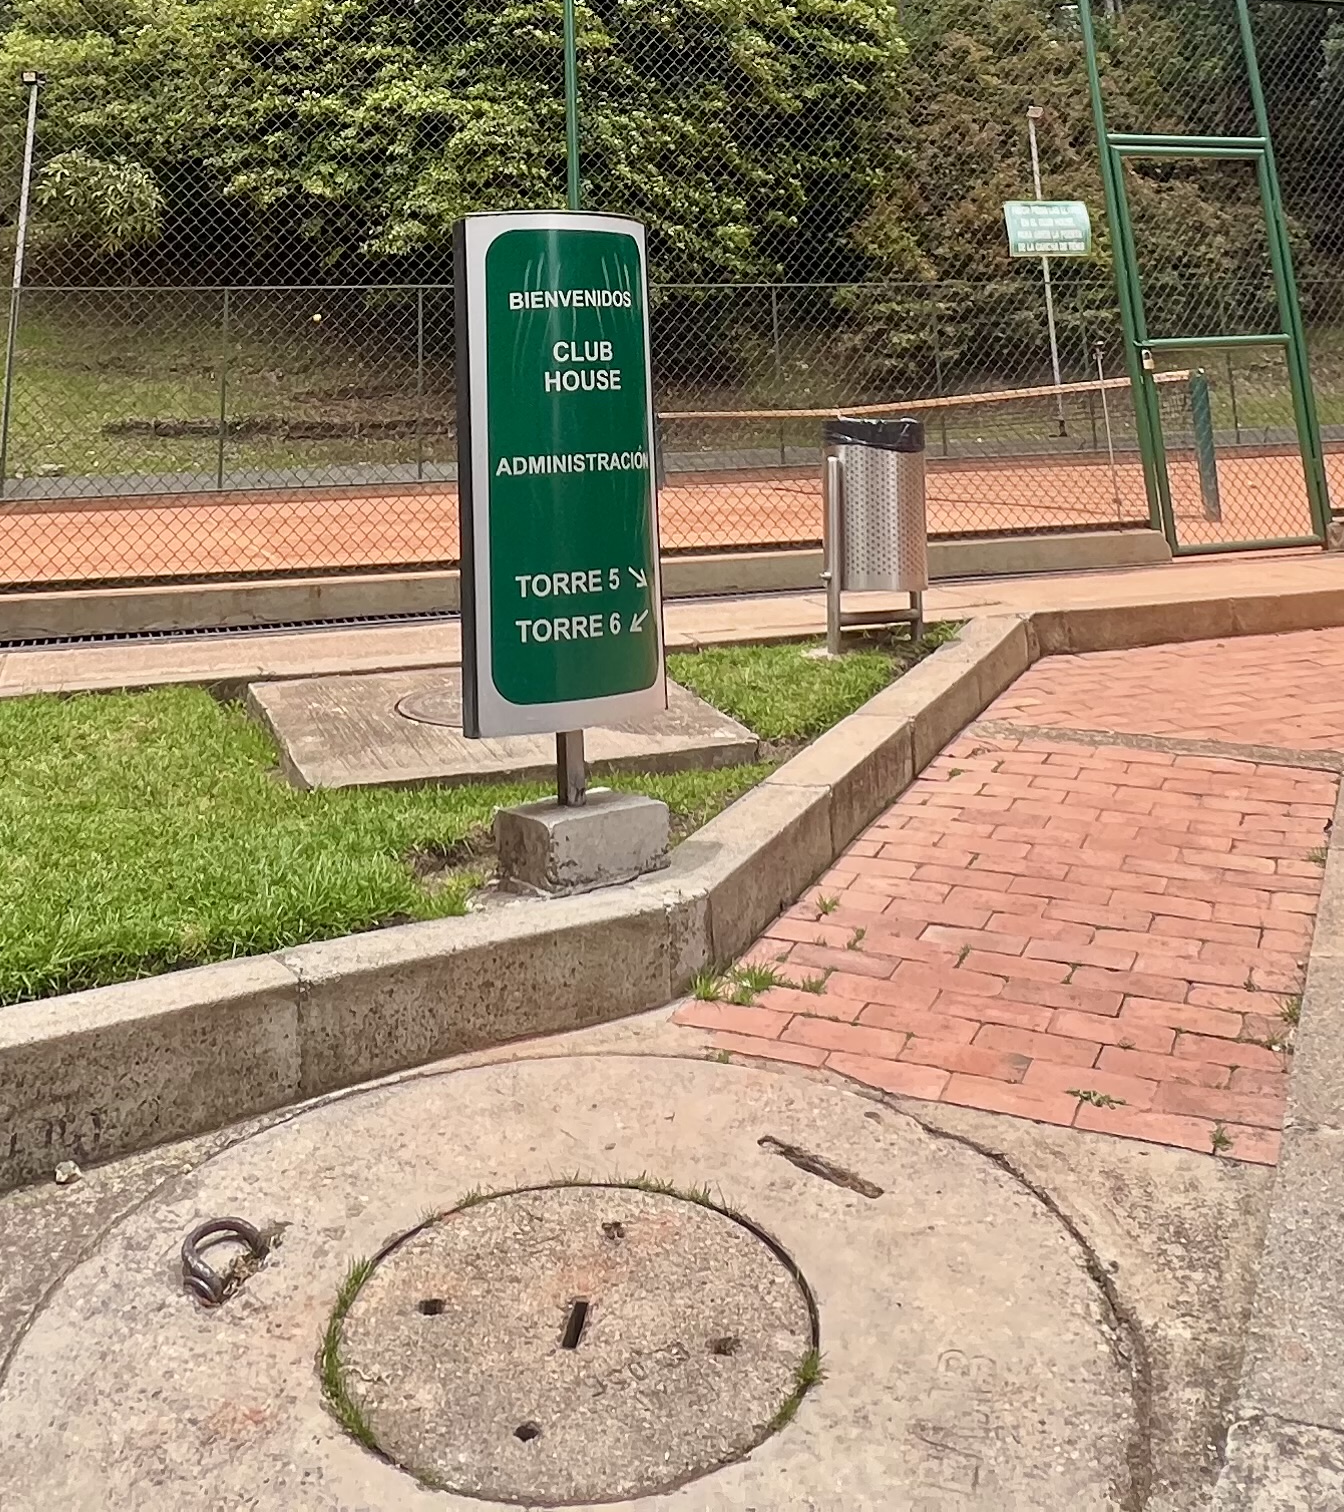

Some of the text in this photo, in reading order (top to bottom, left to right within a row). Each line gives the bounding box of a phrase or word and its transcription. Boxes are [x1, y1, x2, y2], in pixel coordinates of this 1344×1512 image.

[509, 290, 632, 310] BIENVENIDOS
[553, 341, 613, 362] CLUB
[544, 369, 622, 393] HOUSE
[515, 567, 620, 598] TORRE 5
[515, 612, 621, 643] TORRE 6
